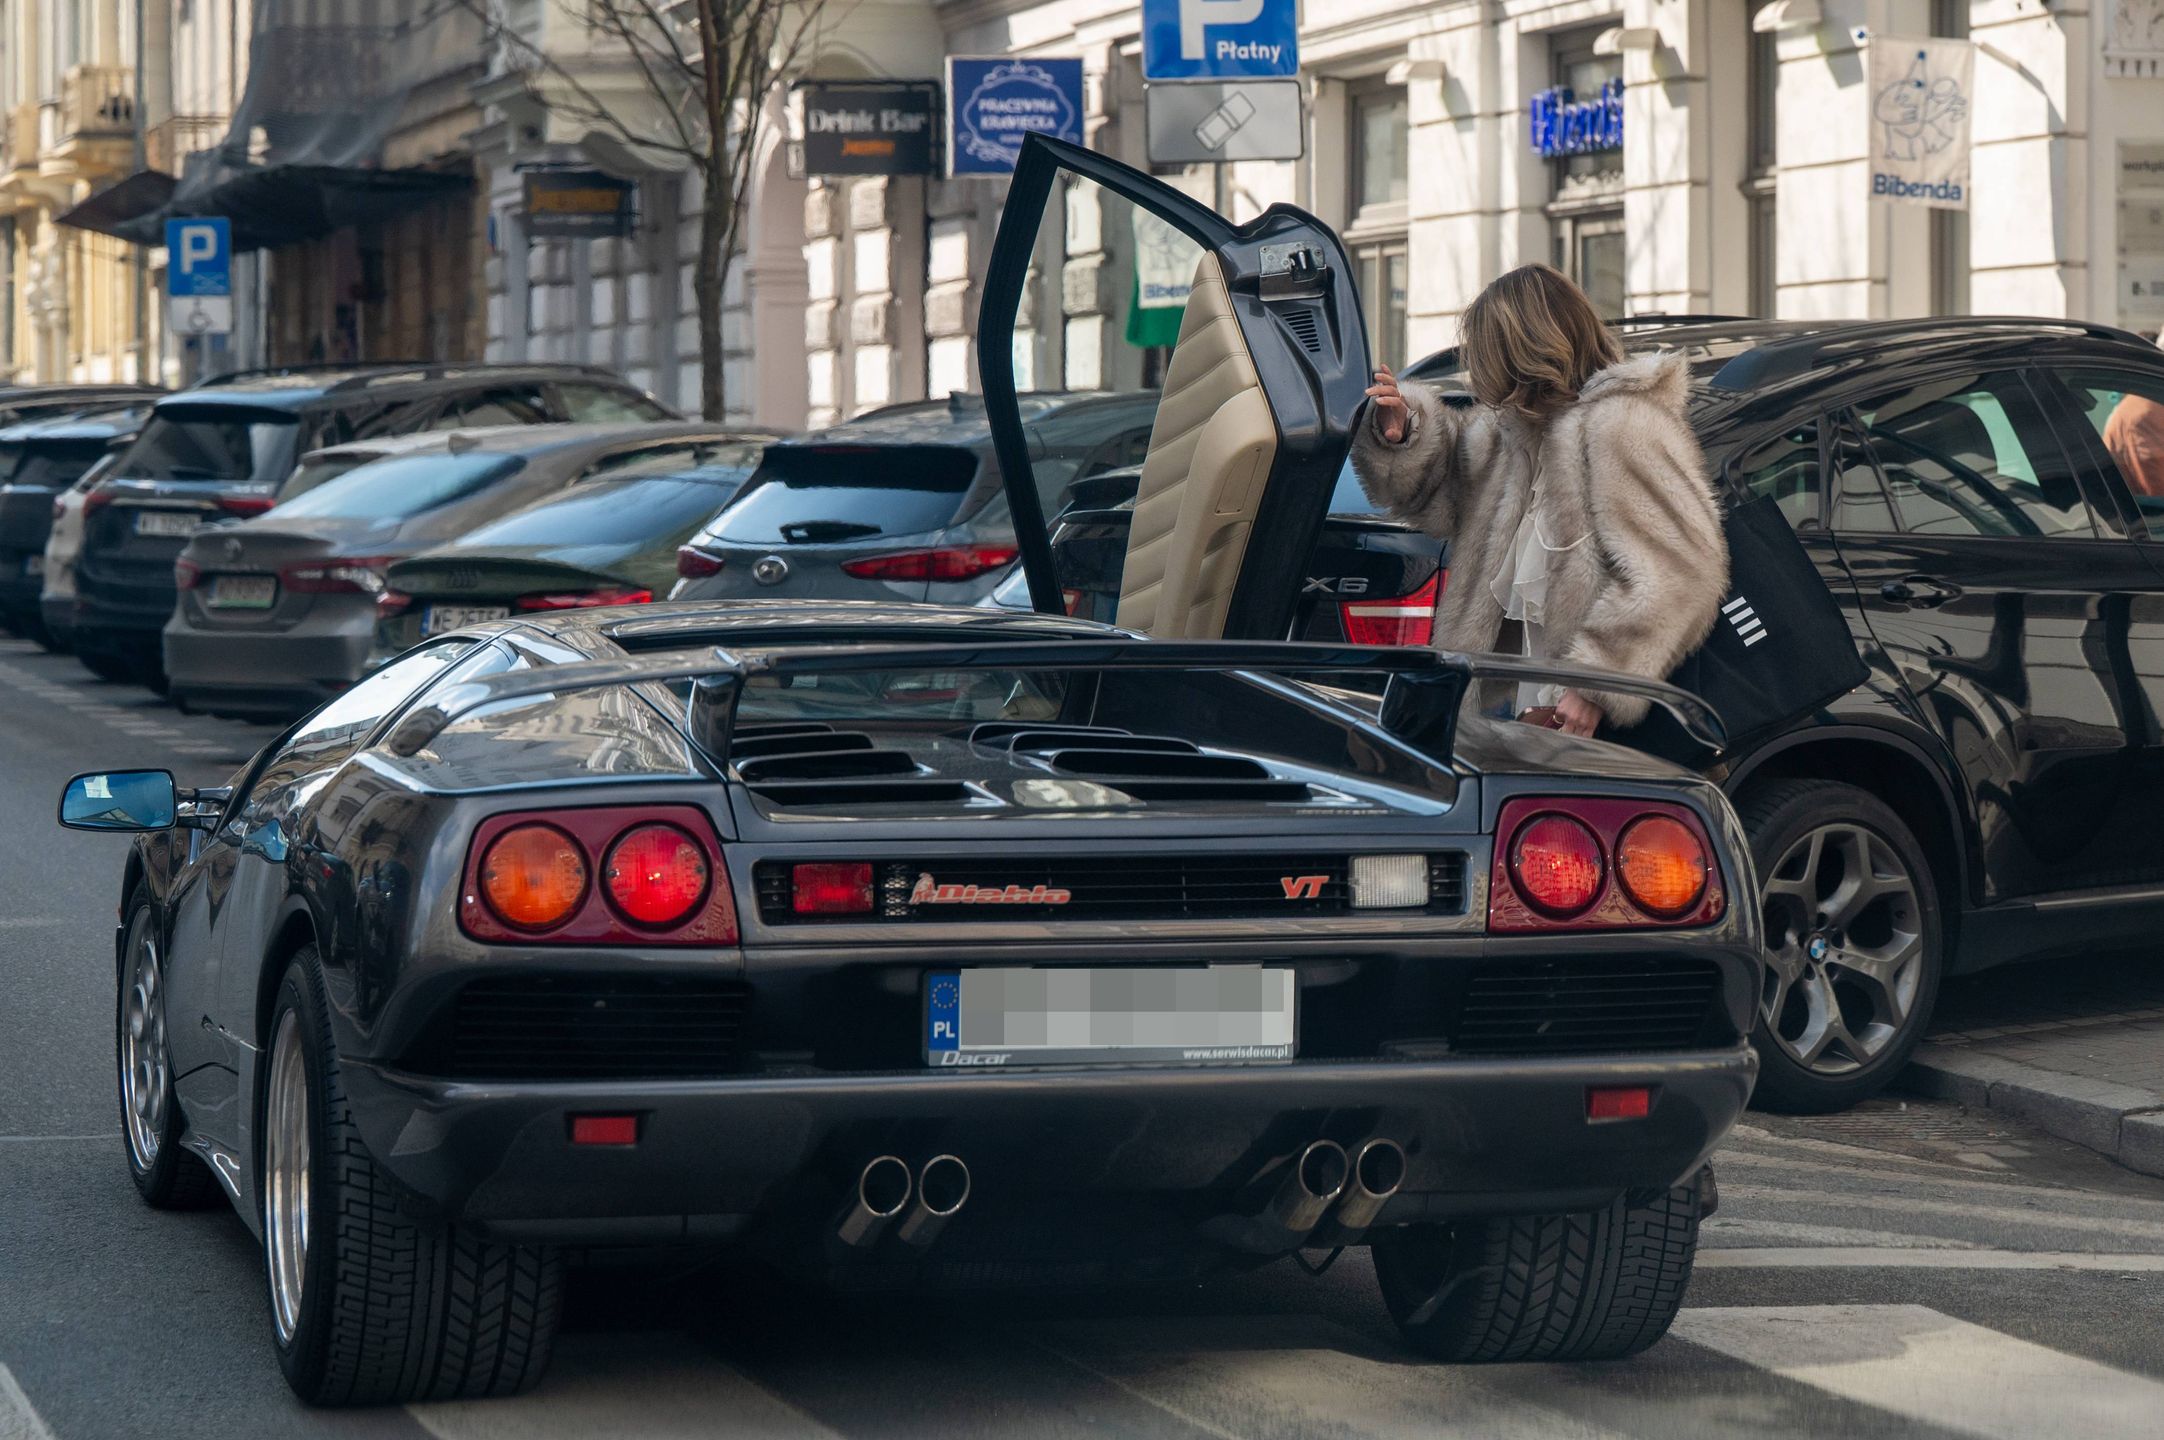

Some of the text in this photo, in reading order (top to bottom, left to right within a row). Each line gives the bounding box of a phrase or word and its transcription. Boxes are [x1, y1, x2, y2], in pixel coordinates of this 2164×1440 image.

[1216, 40, 1281, 64] Płatny
[809, 109, 928, 133] Drink Bar
[1872, 174, 1962, 200] Bibenda
[180, 225, 217, 274] P
[1301, 577, 1369, 593] X6
[935, 884, 1071, 904] Diablo
[1280, 875, 1330, 899] VT
[933, 1021, 955, 1039] PL
[941, 1050, 1011, 1066] Dacar
